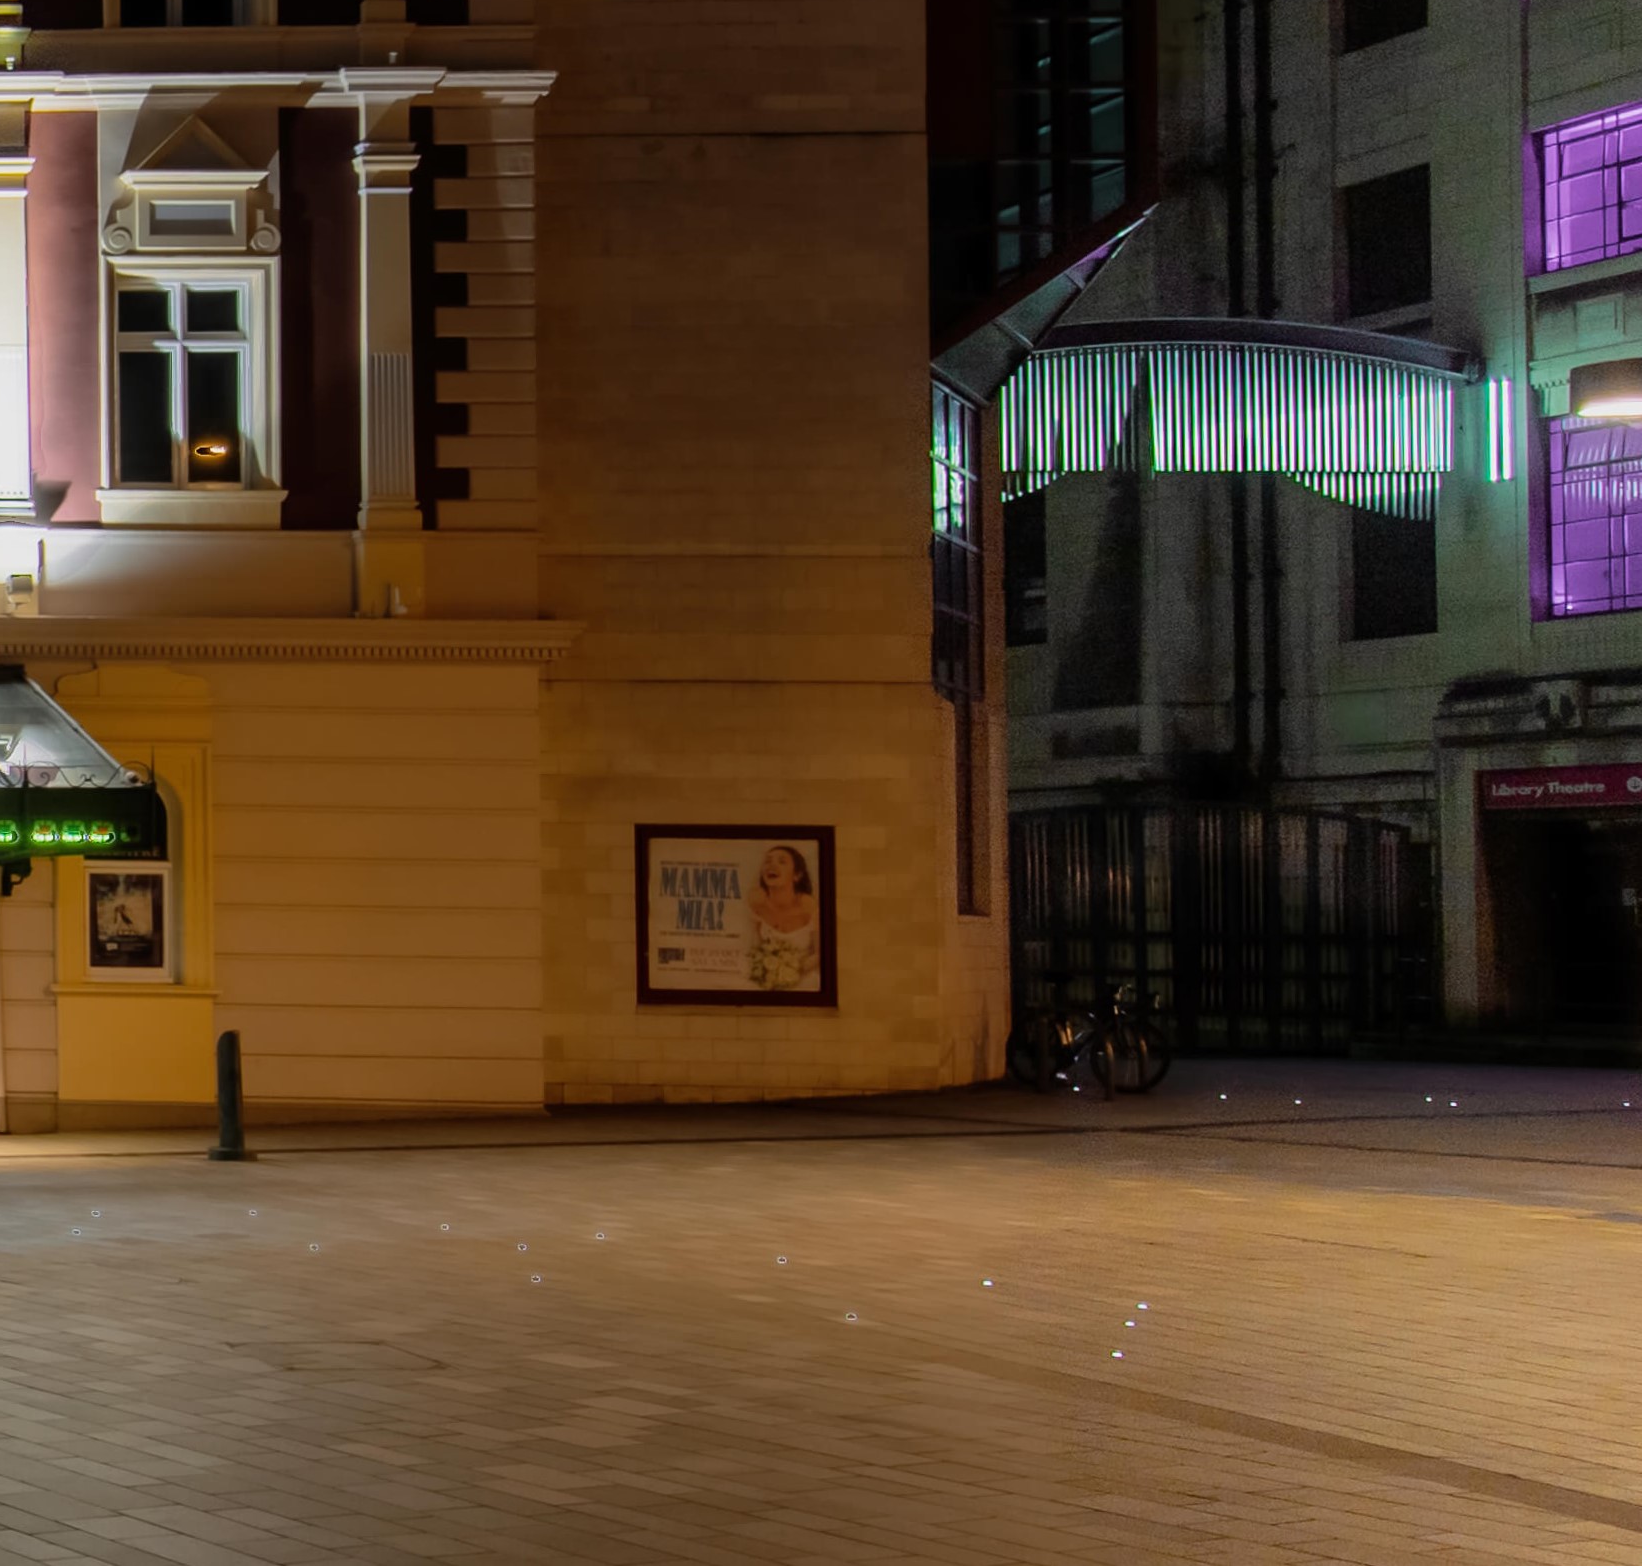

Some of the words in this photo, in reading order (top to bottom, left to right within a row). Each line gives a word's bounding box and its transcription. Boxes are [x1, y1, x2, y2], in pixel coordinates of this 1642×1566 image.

[1492, 783, 1544, 798] Library
[1547, 781, 1605, 794] Theatre
[659, 866, 742, 900] MAMMA
[676, 899, 725, 931] MIA!
